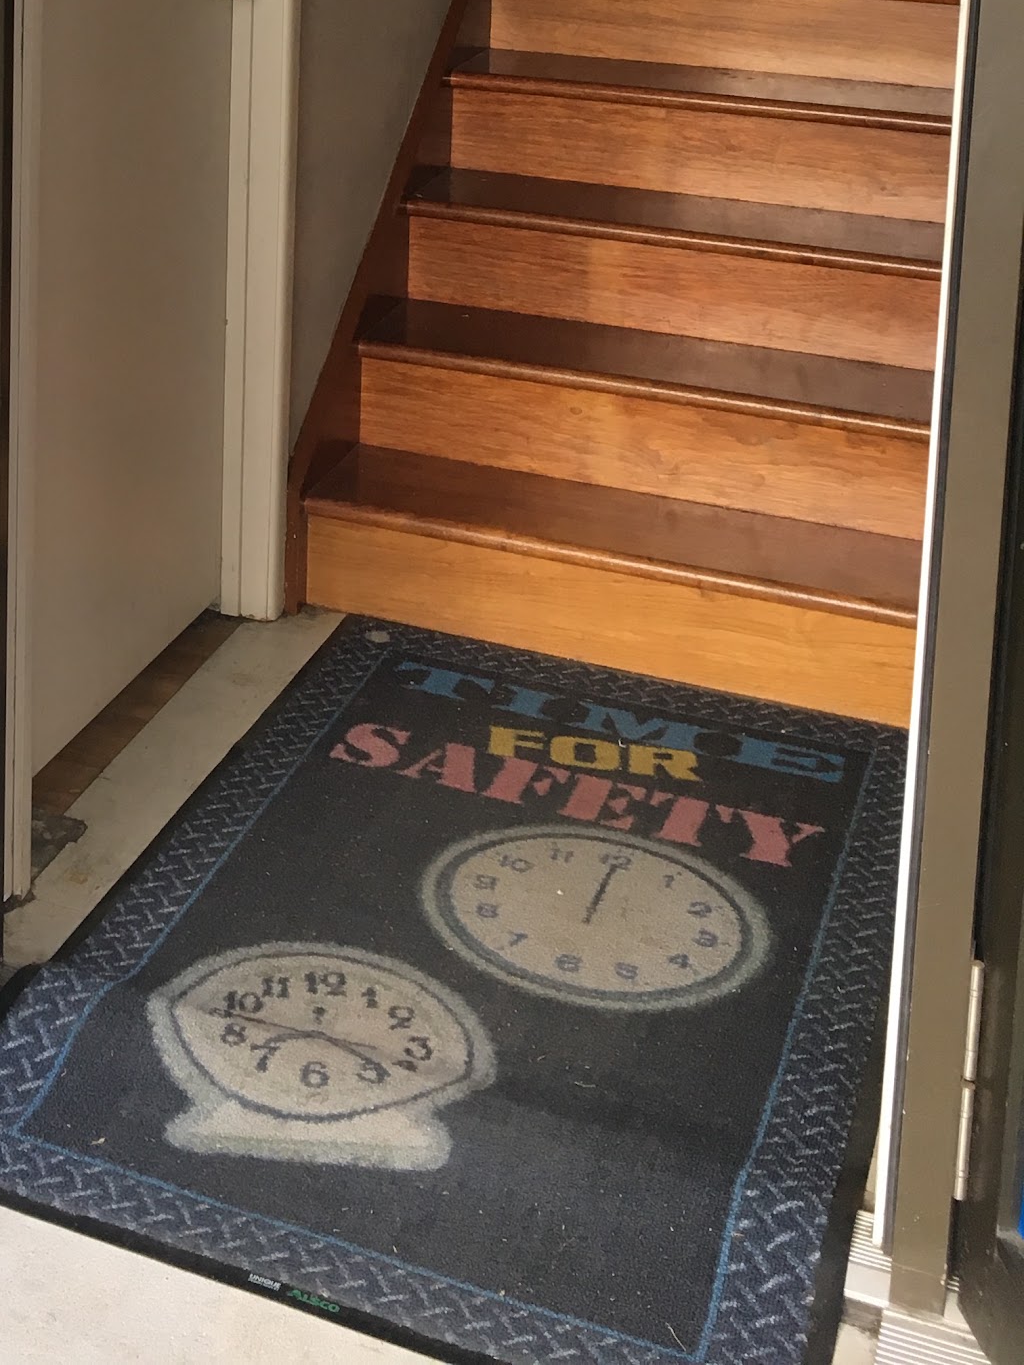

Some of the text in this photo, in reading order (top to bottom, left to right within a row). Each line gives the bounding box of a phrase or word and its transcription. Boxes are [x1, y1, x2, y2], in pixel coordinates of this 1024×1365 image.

[397, 661, 845, 783] TIME
[487, 725, 699, 781] FOR
[329, 723, 825, 867] SAFETY
[499, 854, 536, 873] 10
[261, 975, 290, 998] 11
[304, 971, 347, 997] 12
[223, 990, 264, 1014] 10
[361, 986, 378, 1009] 1
[387, 1005, 415, 1031] 2
[403, 1036, 433, 1061] 3
[298, 1060, 330, 1089] 6
[249, 1273, 281, 1289] UNIQUE
